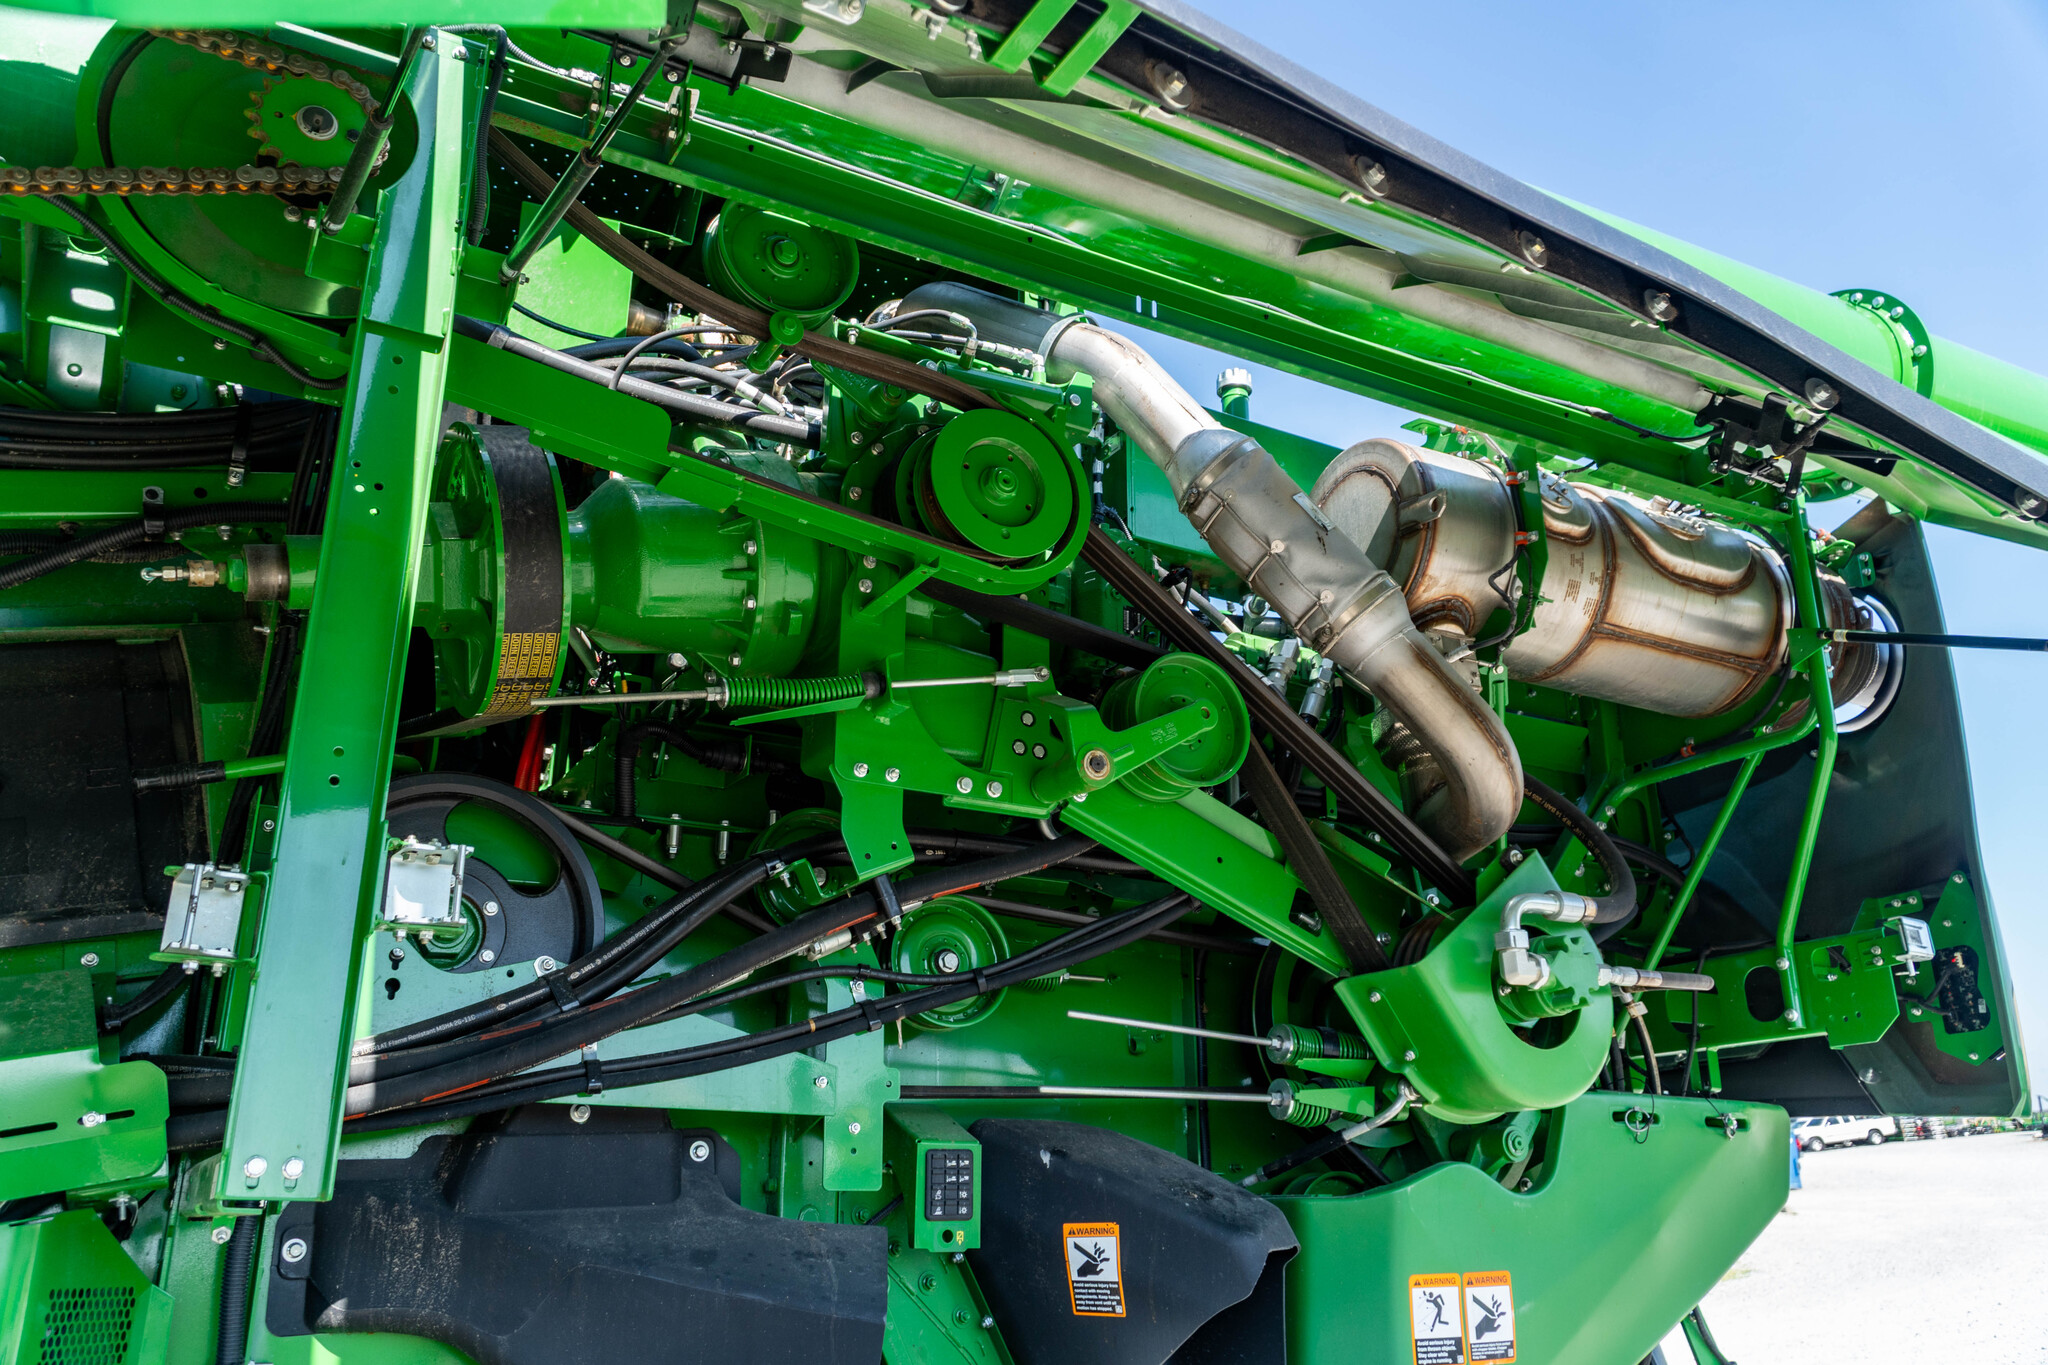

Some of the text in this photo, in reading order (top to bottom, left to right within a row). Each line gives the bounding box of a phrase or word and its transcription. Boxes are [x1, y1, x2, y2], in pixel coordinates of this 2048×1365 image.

[510, 634, 521, 654] JOHN
[522, 634, 532, 654] JOHN
[529, 634, 544, 677] JOHN DEERE
[540, 634, 556, 677] JOHN DEERE
[1544, 802, 1556, 814] BAR
[388, 1036, 408, 1048] Flame
[407, 1028, 436, 1040] Resistant
[436, 1022, 454, 1033] MSHA
[1076, 1227, 1114, 1235] WARNING
[1423, 1277, 1456, 1286] WARNING
[1474, 1275, 1508, 1284] WARNING
